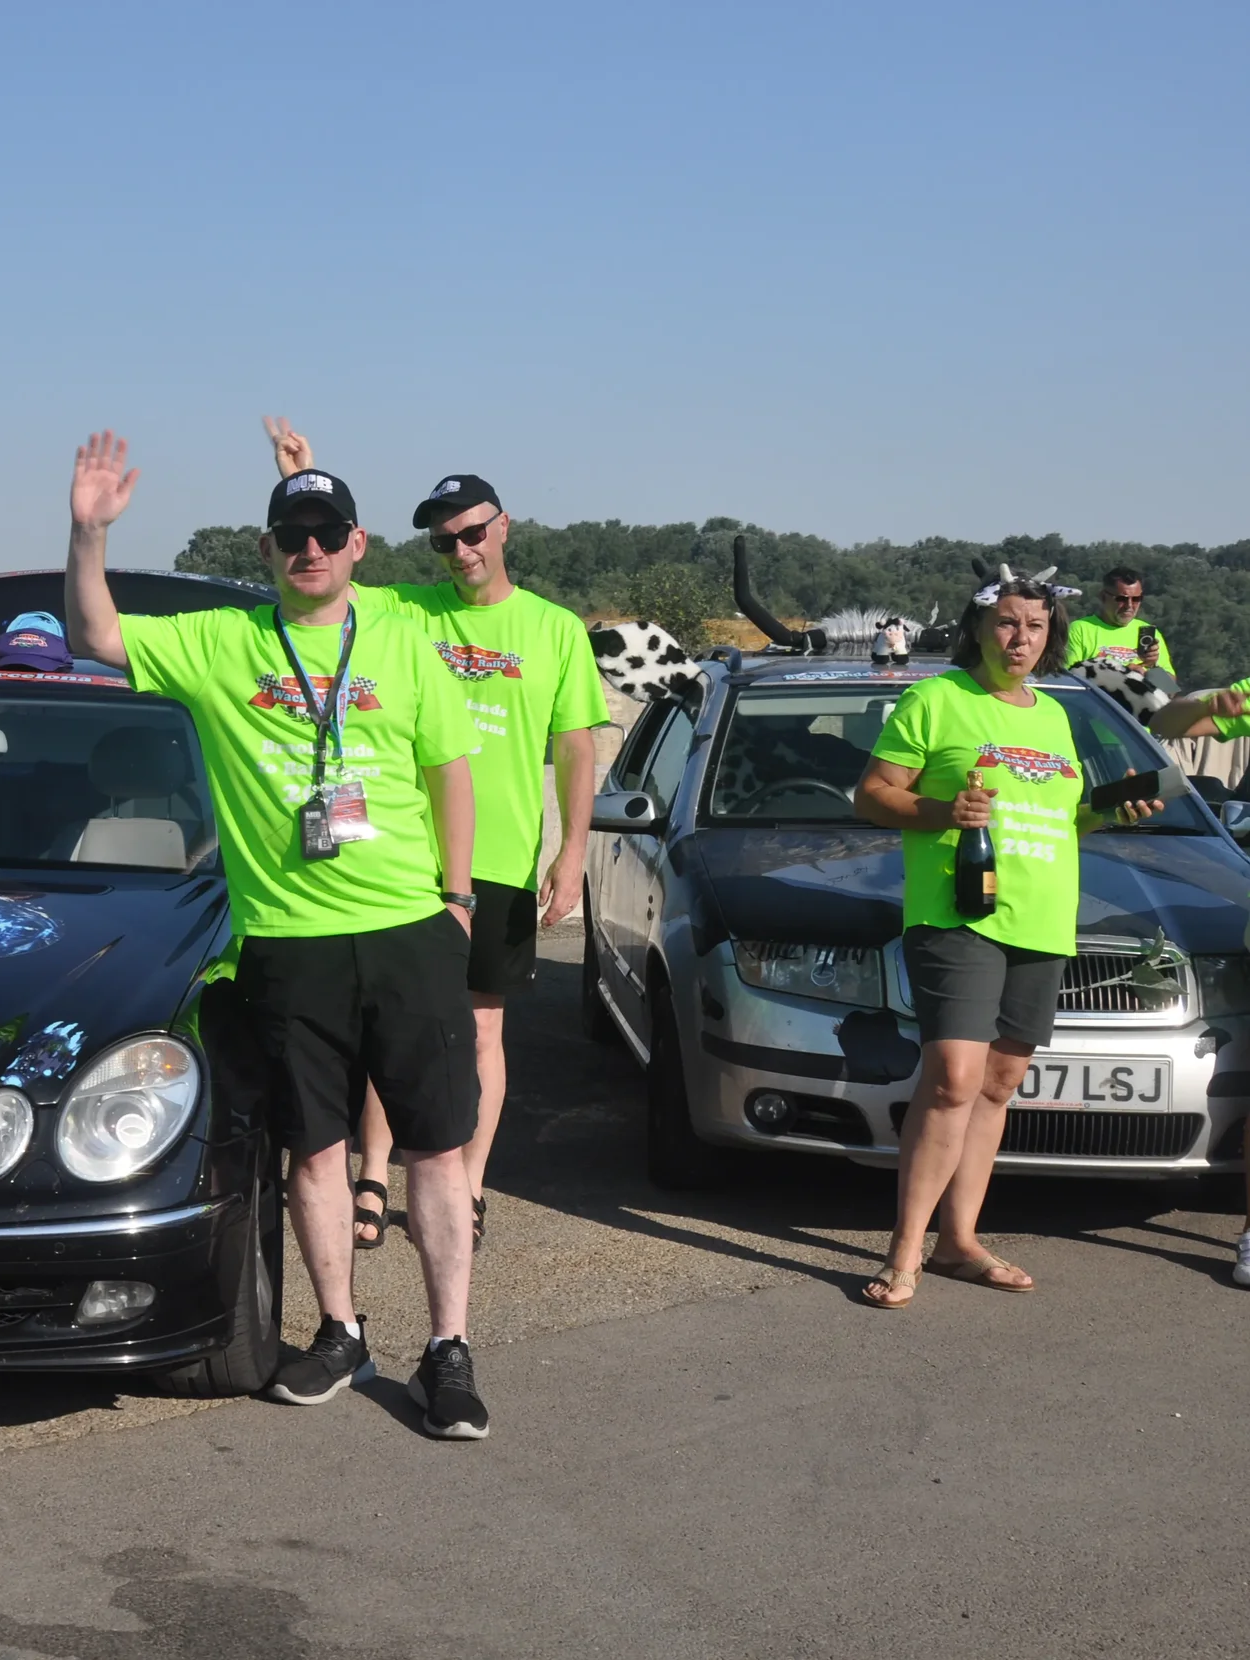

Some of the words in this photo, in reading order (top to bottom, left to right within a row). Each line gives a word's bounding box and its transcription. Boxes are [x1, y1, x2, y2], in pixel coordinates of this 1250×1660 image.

[441, 651, 474, 667] Wacky
[478, 659, 508, 669] Rally
[466, 699, 508, 717] lands
[992, 752, 1030, 767] Wacky
[1034, 760, 1062, 770] Rally
[1000, 838, 1055, 862] 2025
[1016, 1064, 1068, 1100] 07
[1082, 1065, 1162, 1103] LSJ
